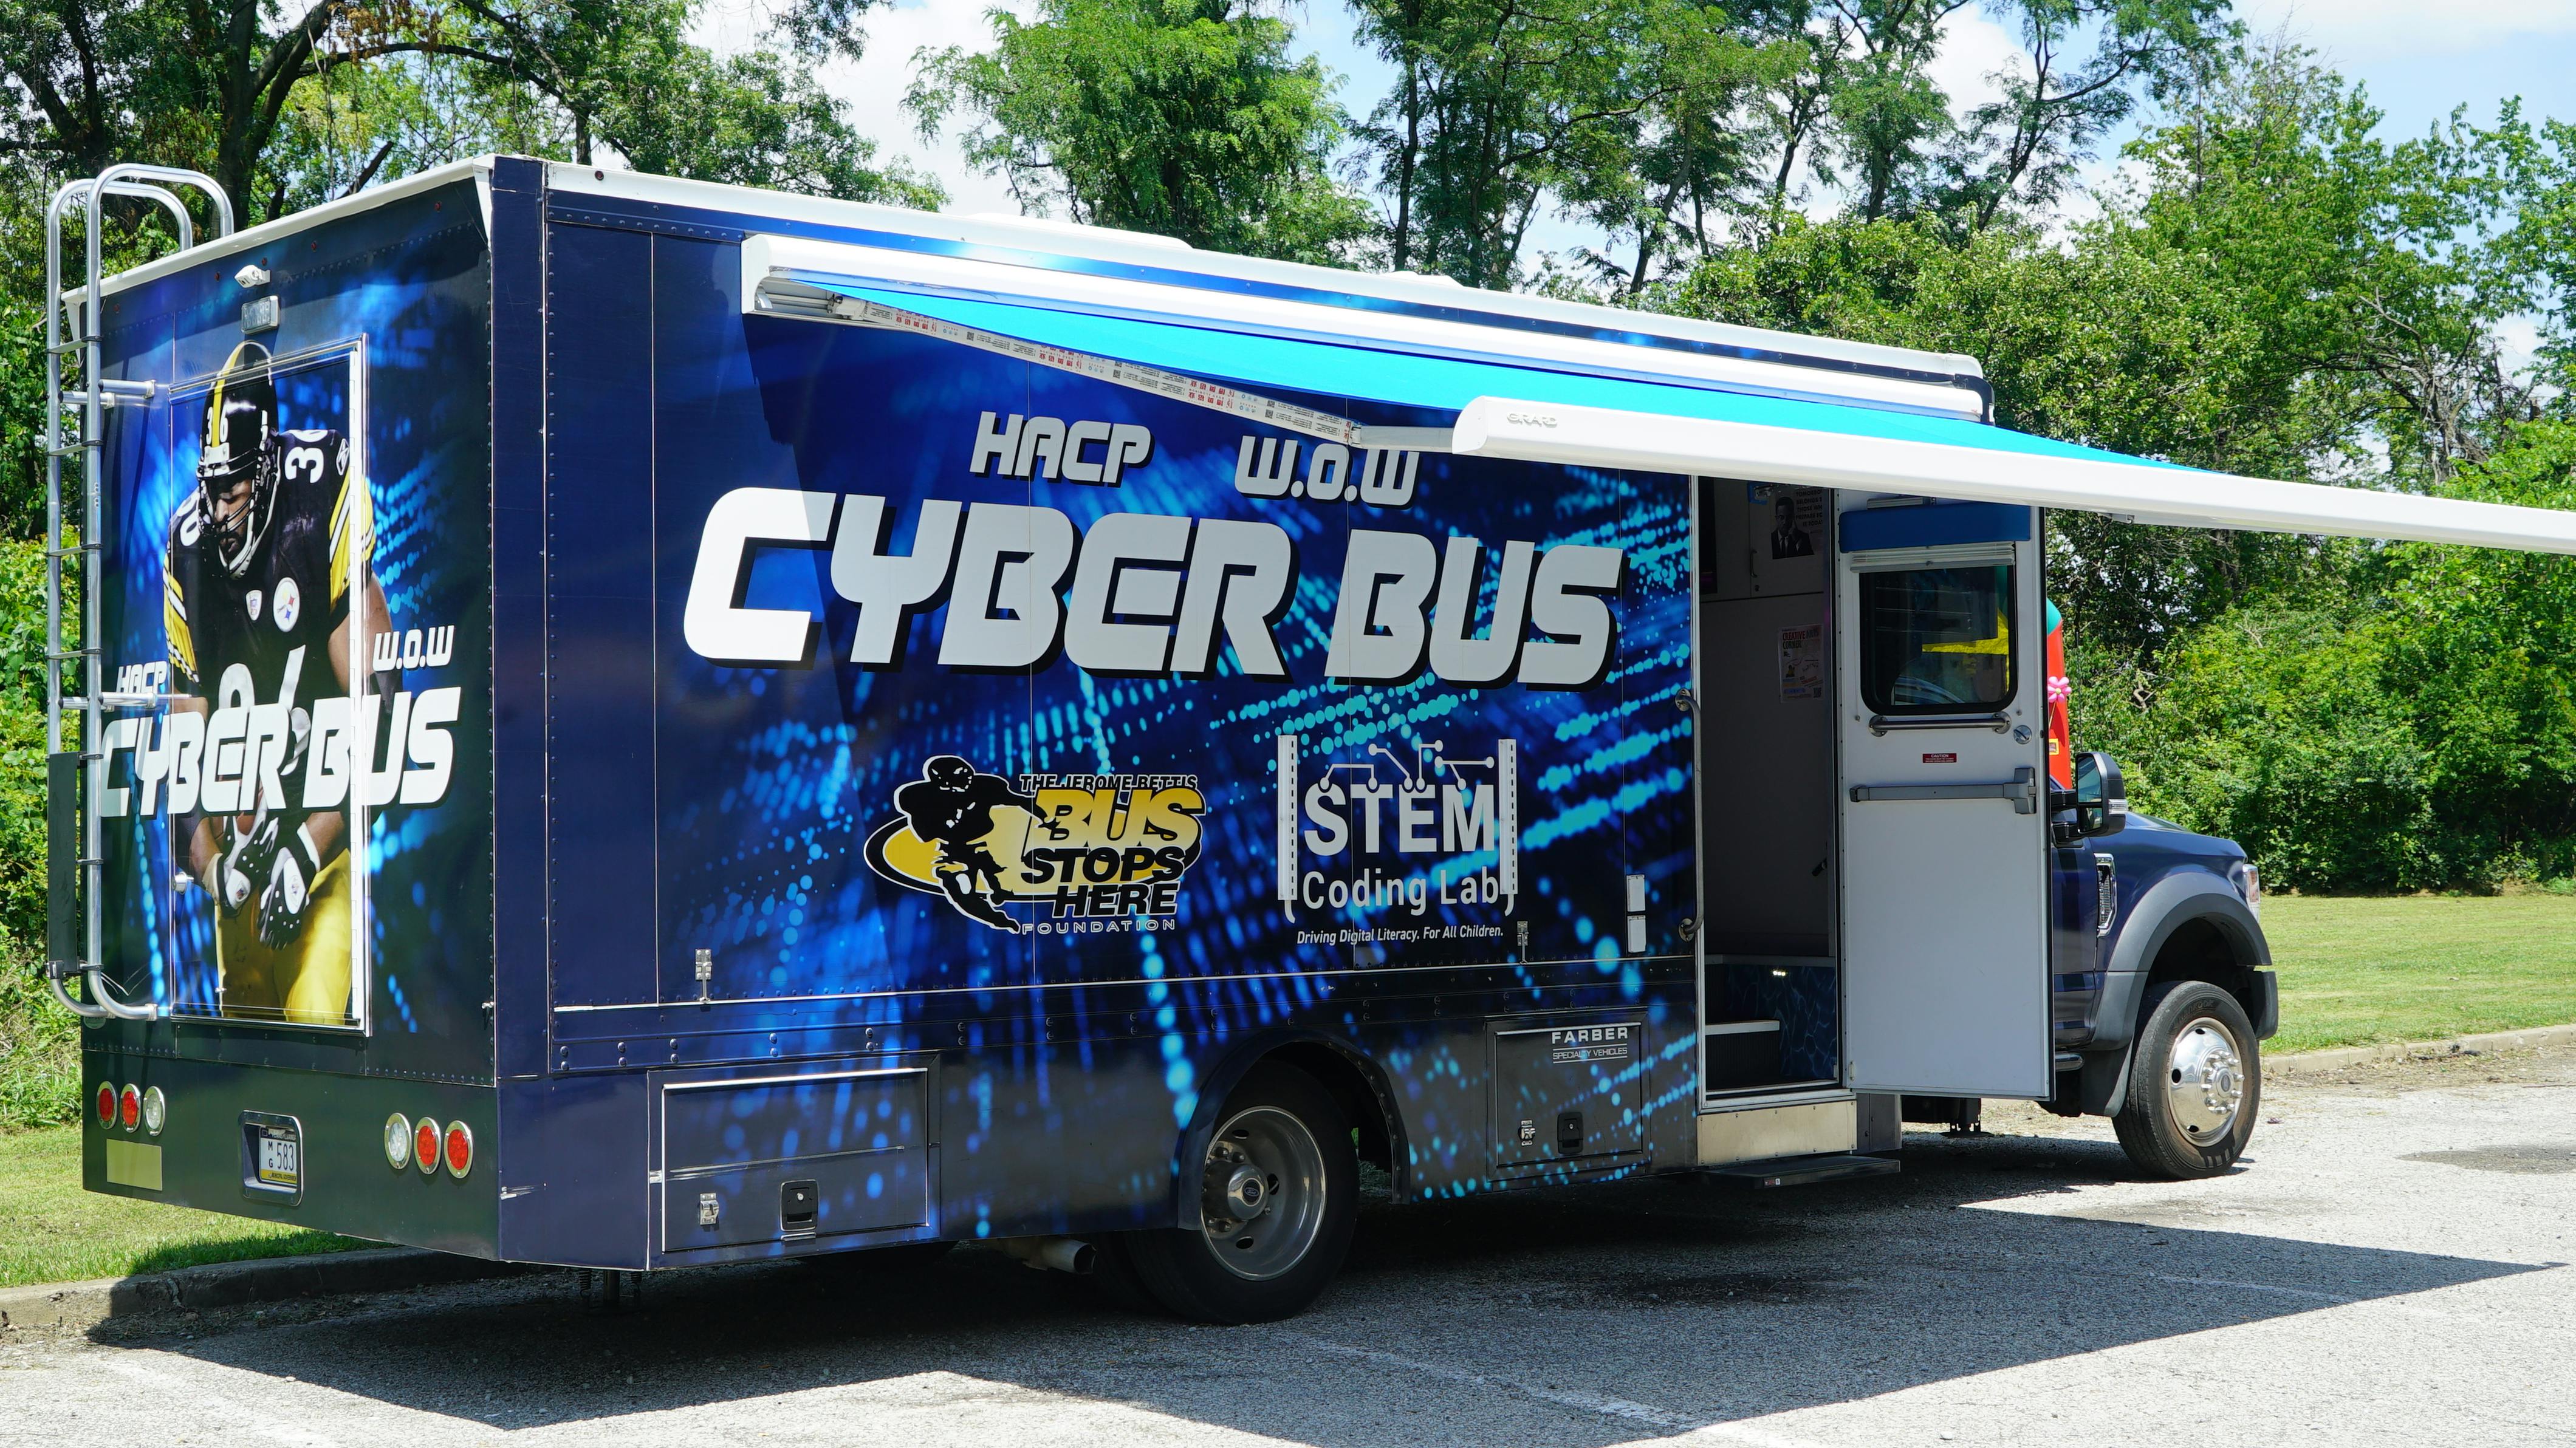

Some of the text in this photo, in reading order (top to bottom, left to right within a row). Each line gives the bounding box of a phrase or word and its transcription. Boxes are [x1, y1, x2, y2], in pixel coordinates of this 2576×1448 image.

[1506, 412, 1558, 428] GIRARD
[970, 411, 1420, 507] HACP W.O.W
[684, 487, 1624, 685] CYBER BUS
[1783, 631, 1806, 641] CREATIVE
[1783, 640, 1802, 649] CORNER
[117, 625, 454, 695] HACP W.O.W
[101, 703, 287, 818] CYBER
[303, 687, 461, 808] BUS
[1019, 774, 1198, 791] THE JEROME BETTIS
[1024, 788, 1206, 852] BUS
[1304, 783, 1495, 856] STEM
[1021, 845, 1186, 884] STOPS
[1052, 881, 1181, 918] HERE
[1303, 866, 1499, 916] Coding Lab
[1022, 919, 1176, 935] FOUNDATION
[1297, 924, 1504, 946] Driving Digital Literacy. For All Children.
[1552, 1027, 1628, 1044] FARBER
[1552, 1047, 1628, 1060] SPECIALTY VEHICLES
[268, 1141, 273, 1151] M
[277, 1142, 294, 1172] 583
[269, 1158, 273, 1168] G
